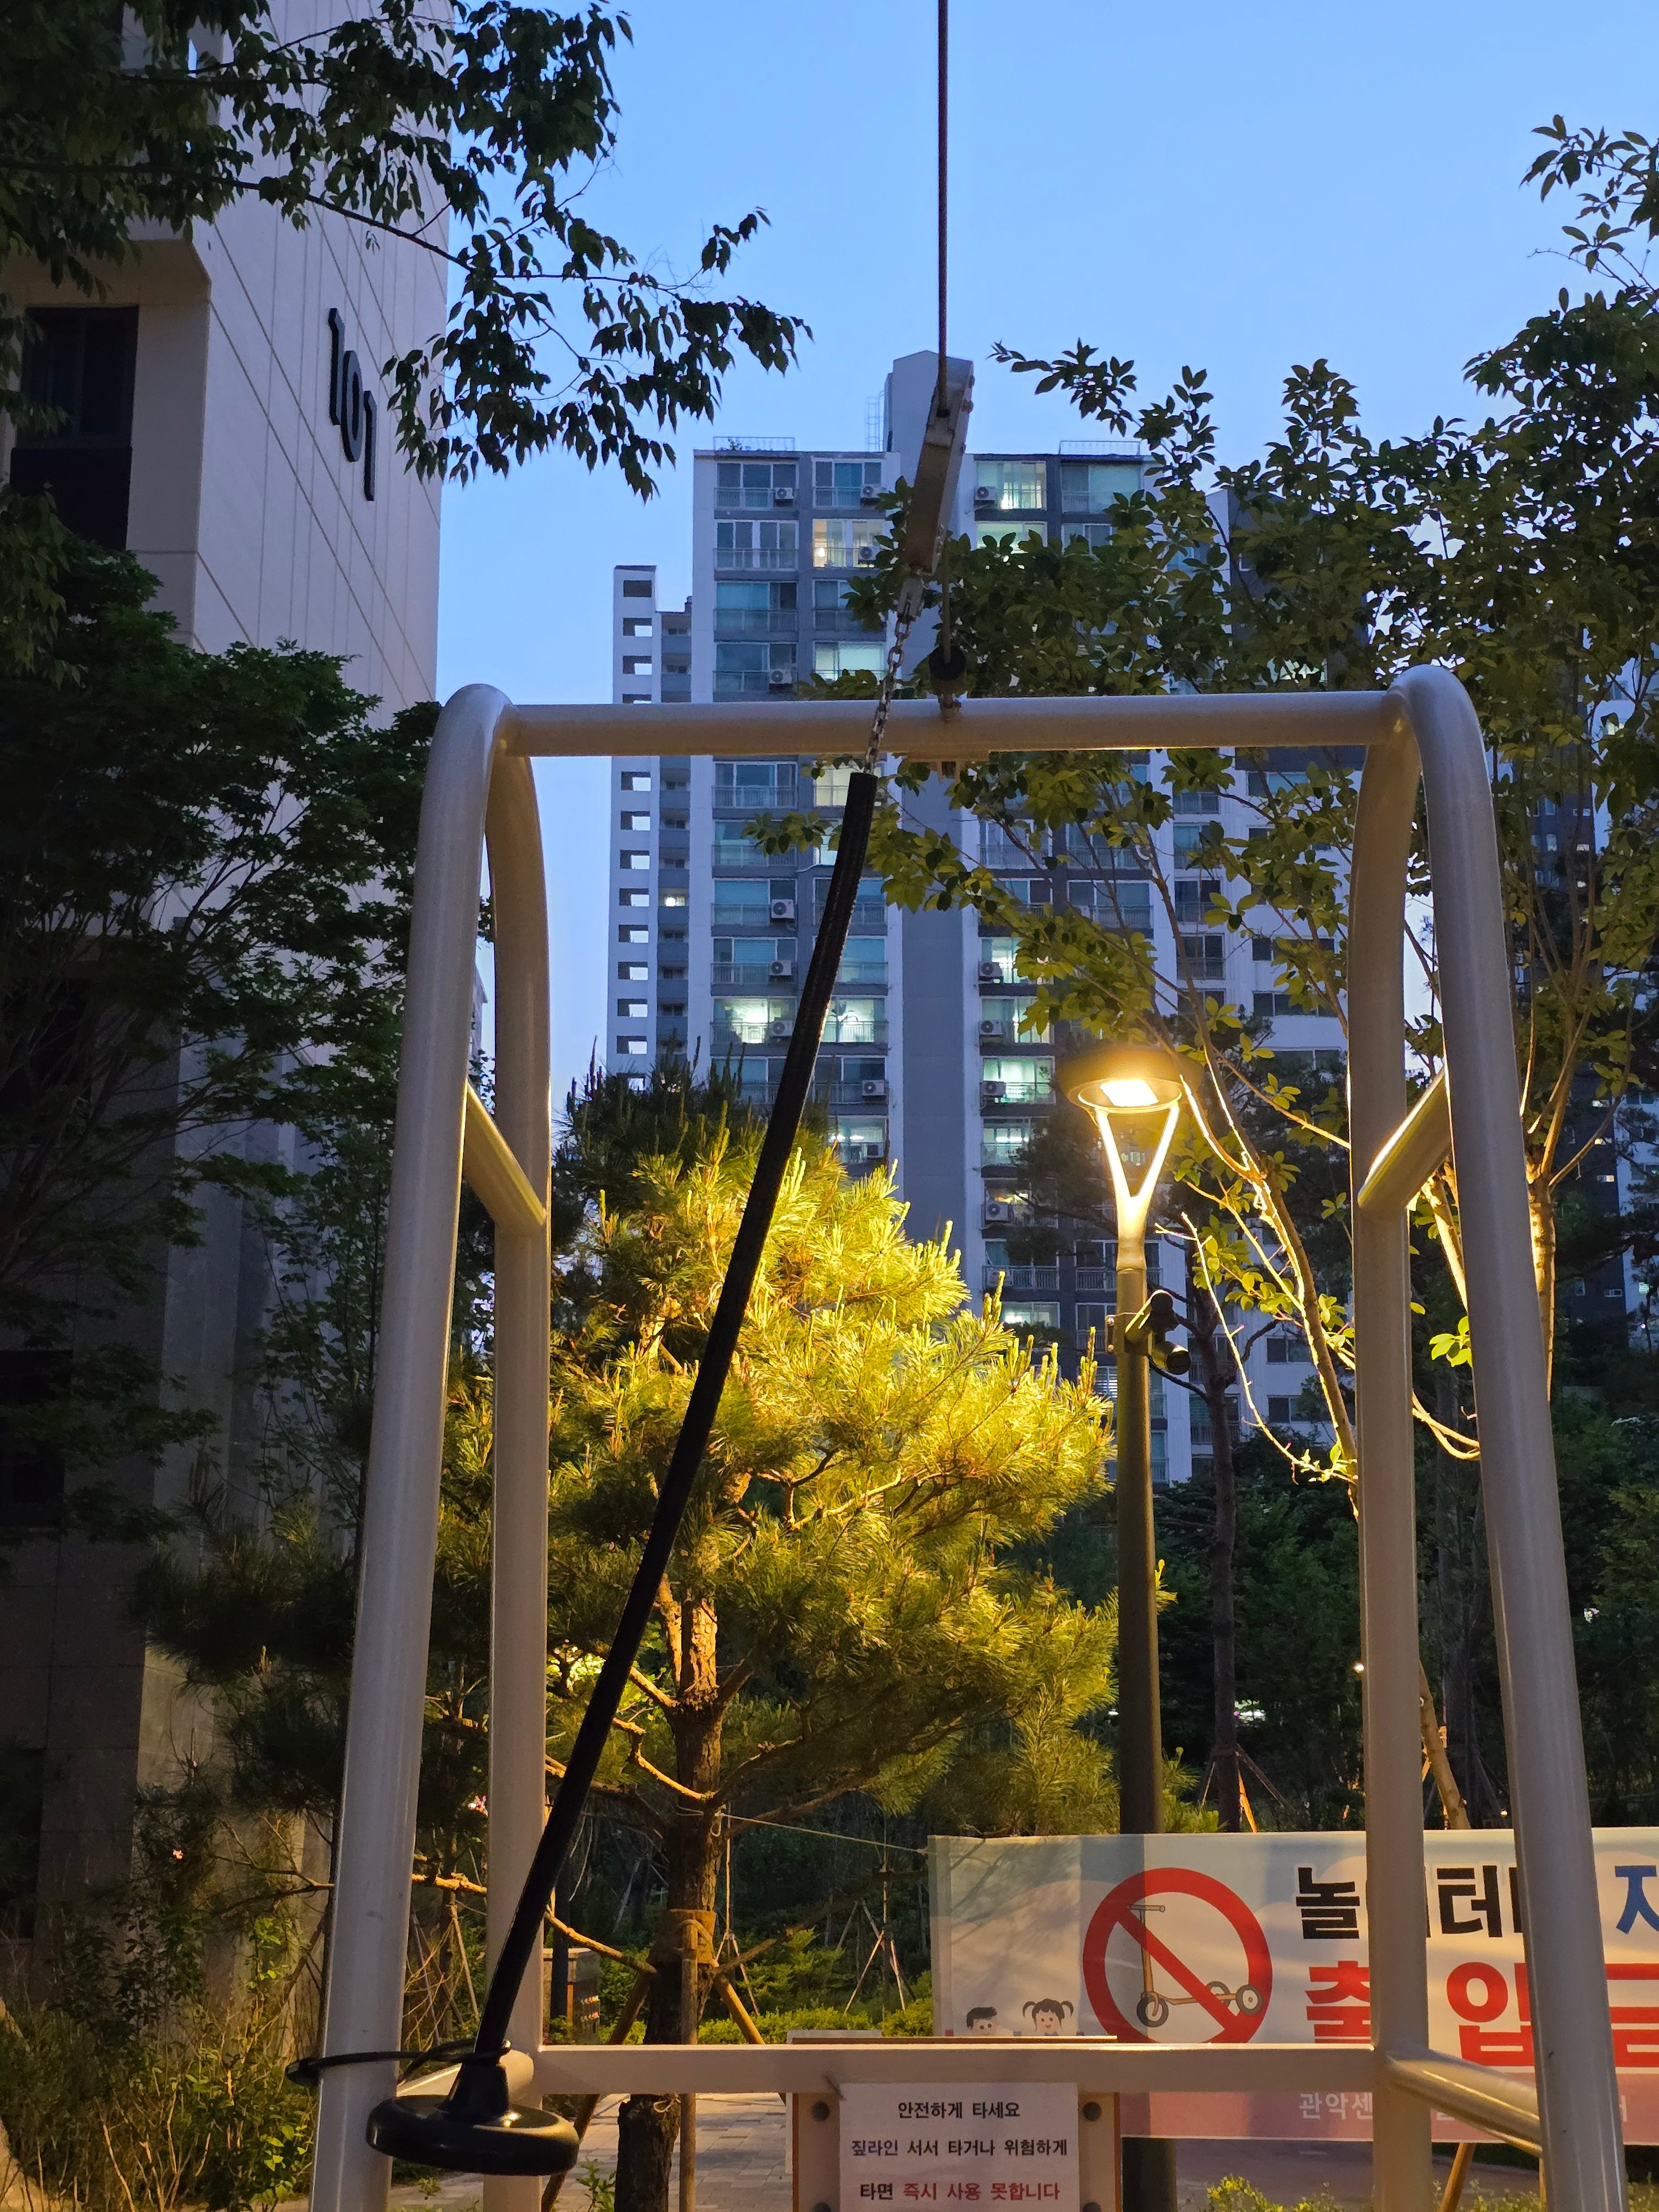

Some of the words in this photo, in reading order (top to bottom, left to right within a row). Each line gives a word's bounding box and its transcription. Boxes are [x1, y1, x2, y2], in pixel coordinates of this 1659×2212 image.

[328, 307, 377, 501] 101
[898, 2101, 963, 2119] 안전하게
[972, 2101, 1020, 2119] 타세요
[907, 2140, 939, 2156] 서서
[948, 2139, 996, 2156] 타거나
[1004, 2139, 1067, 2156] 위험하게
[860, 2183, 893, 2200] 타면
[903, 2183, 937, 2200] 즉시
[947, 2183, 981, 2200] 사용
[990, 2182, 1060, 2200] 못합니다
